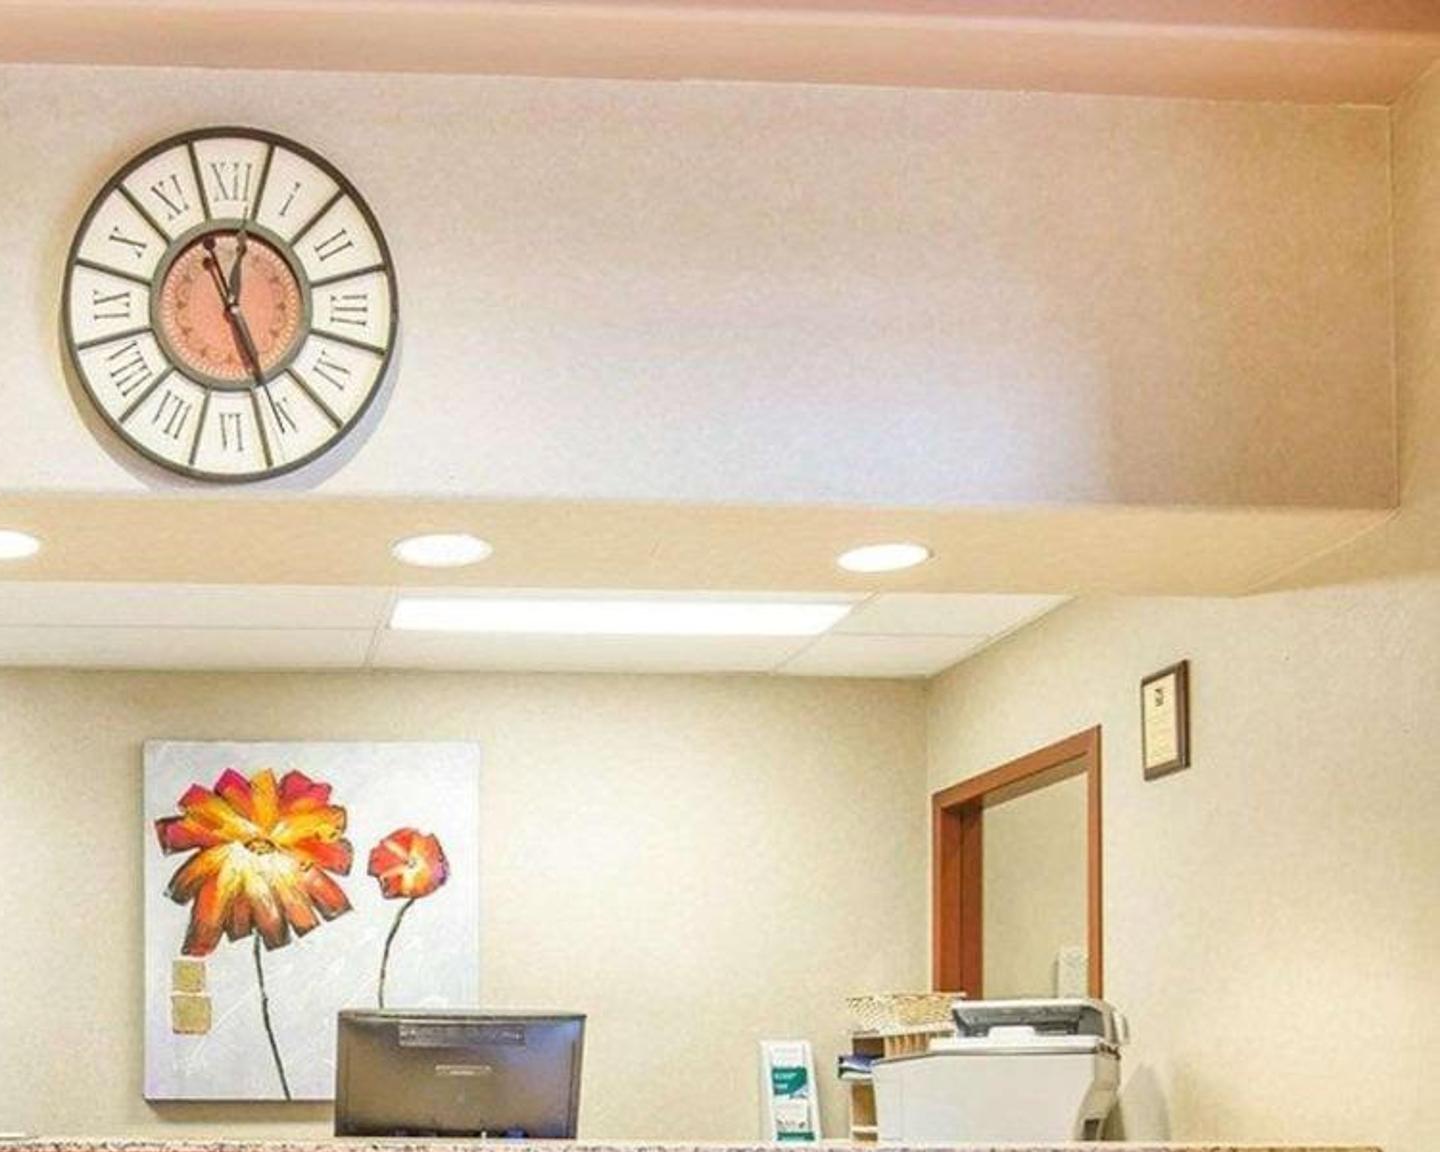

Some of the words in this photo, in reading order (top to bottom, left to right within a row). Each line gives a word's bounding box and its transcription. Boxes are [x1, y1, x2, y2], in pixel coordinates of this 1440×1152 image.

[151, 174, 190, 221] XI
[209, 162, 252, 202] XII
[278, 181, 301, 217] I
[108, 225, 147, 259] X
[313, 228, 354, 262] II
[93, 290, 131, 321] IX
[330, 293, 368, 327] III
[106, 340, 153, 397] VIII
[312, 349, 351, 391] IV
[152, 389, 194, 441] VII
[219, 412, 245, 452] VI
